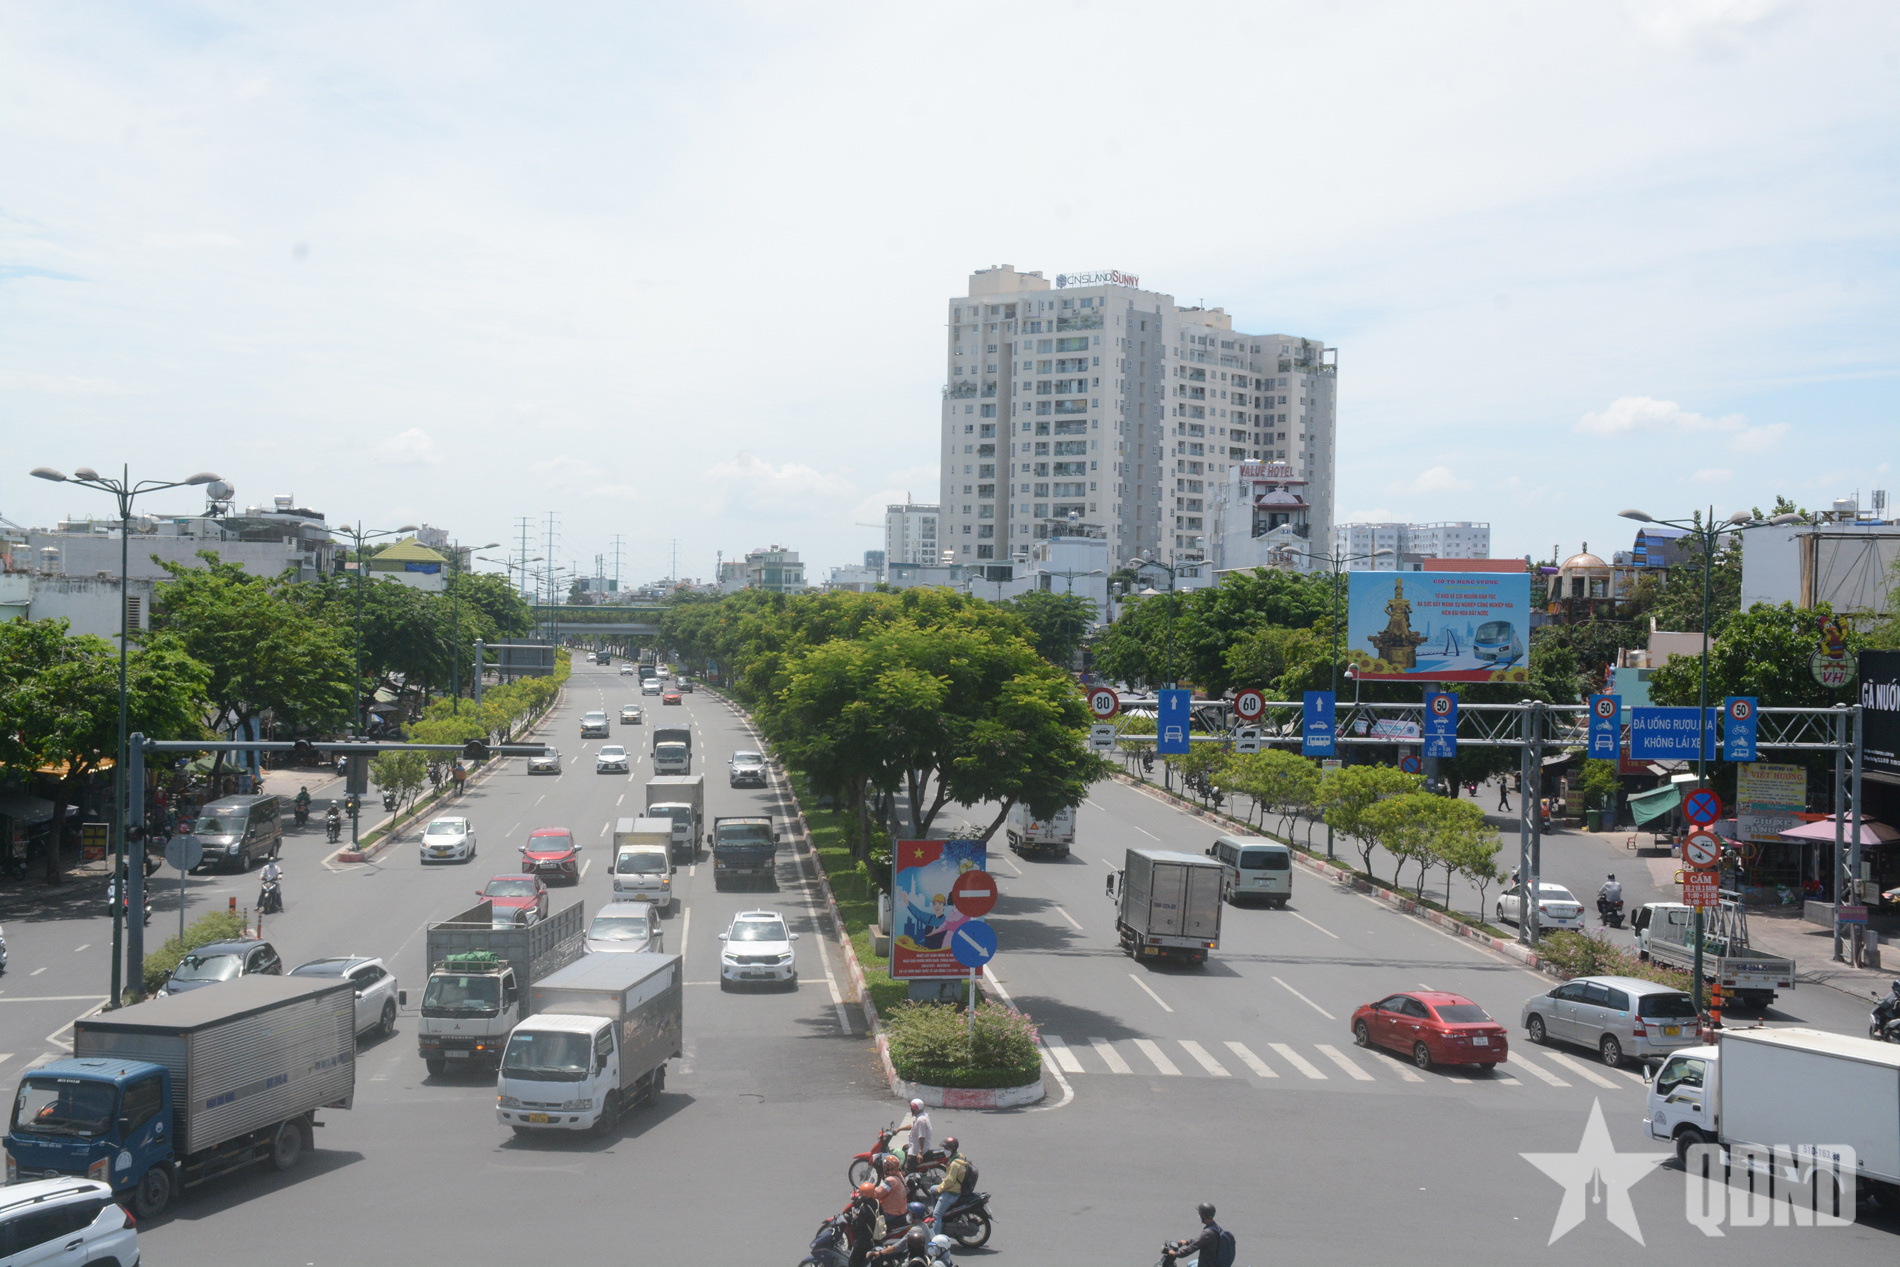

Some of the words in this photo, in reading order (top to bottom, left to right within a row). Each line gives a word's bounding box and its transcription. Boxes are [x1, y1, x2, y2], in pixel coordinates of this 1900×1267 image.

[1240, 465, 1266, 476] VALUE
[1268, 466, 1294, 477] HOTEL
[1862, 678, 1875, 710] GÀ
[1096, 696, 1110, 710] 80
[1243, 697, 1256, 711] 60
[1436, 700, 1447, 711] 50
[1600, 702, 1611, 714] 50
[1736, 704, 1747, 716] 50
[1633, 717, 1646, 729] ĐÃ
[1647, 715, 1671, 730] UỐNG
[1644, 736, 1674, 748] KHÔNG
[1676, 736, 1690, 748] LÁI
[1690, 872, 1712, 884] CẤM
